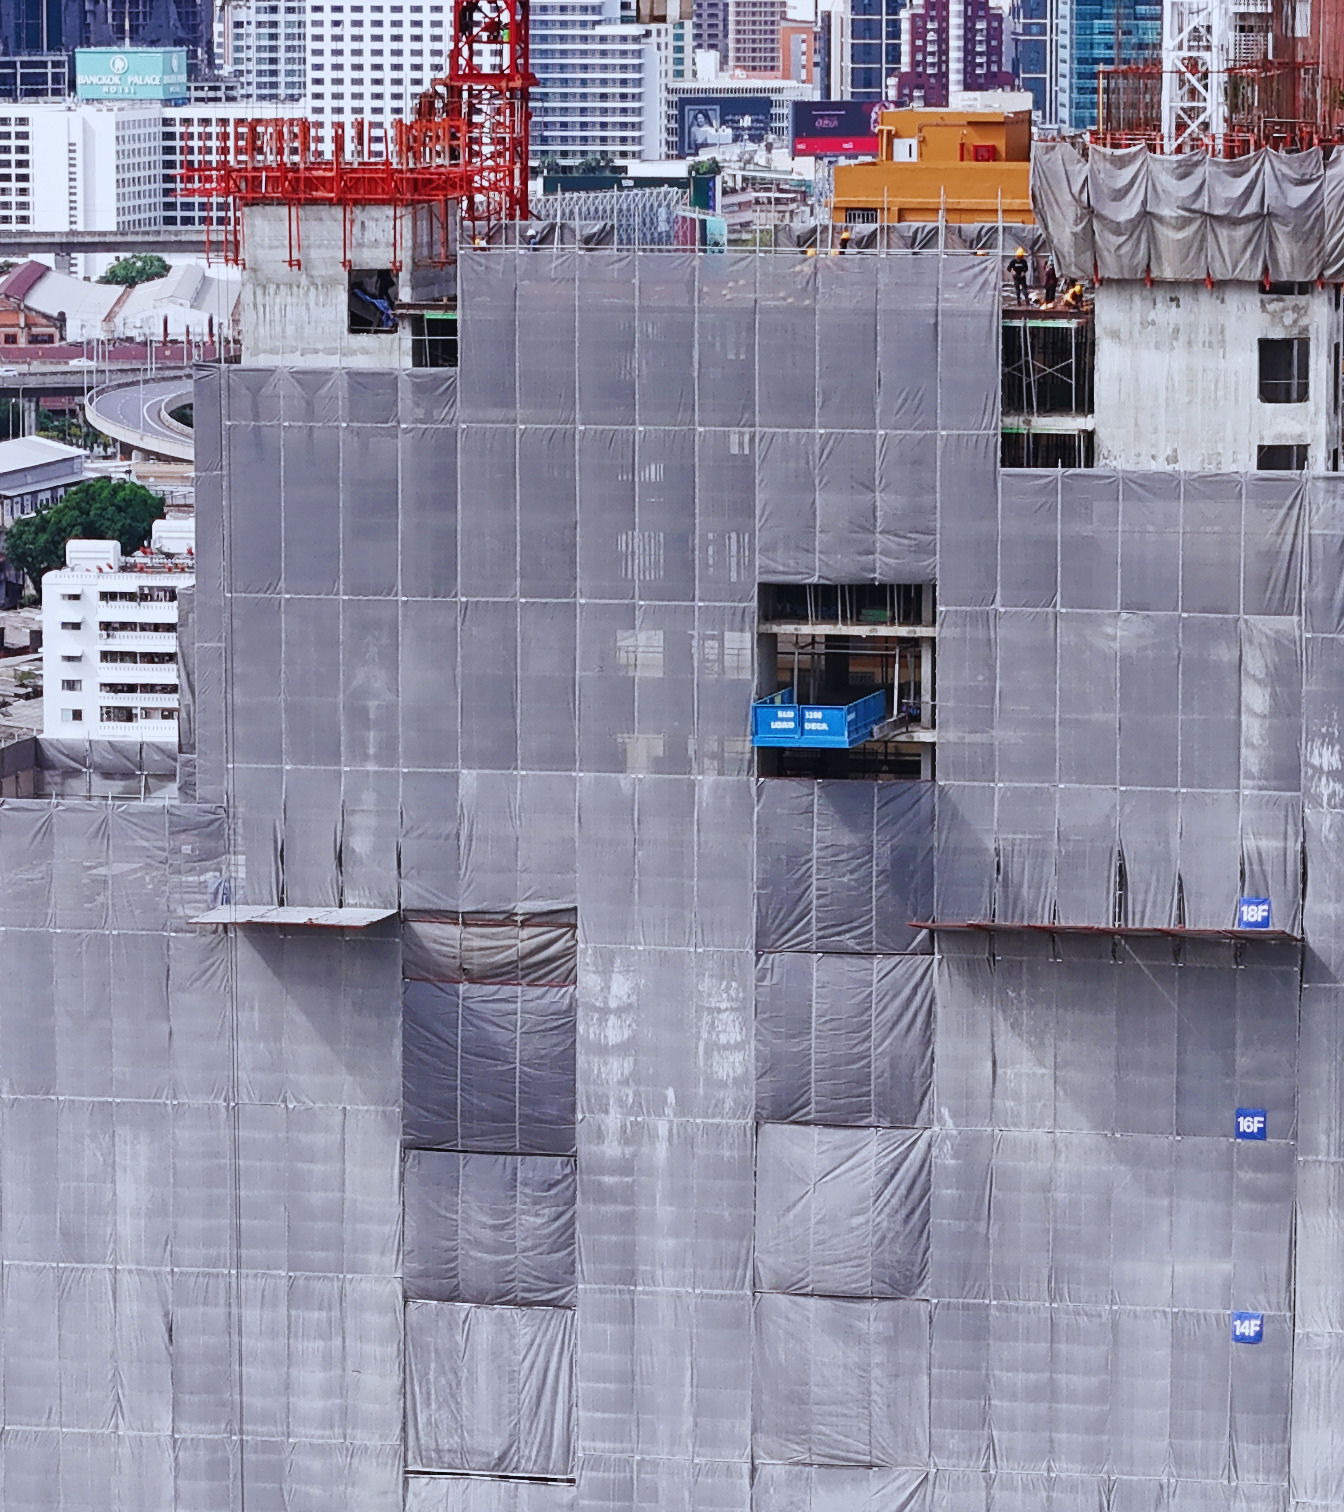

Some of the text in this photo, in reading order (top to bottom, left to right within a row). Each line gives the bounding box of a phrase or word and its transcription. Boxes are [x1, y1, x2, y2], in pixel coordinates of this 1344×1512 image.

[77, 75, 121, 84] BANGKOK
[127, 75, 161, 84] PALACE
[770, 721, 795, 729] LOAD
[1241, 904, 1269, 922] 18F
[1237, 1116, 1265, 1133] 16F
[1233, 1319, 1261, 1337] 14F
